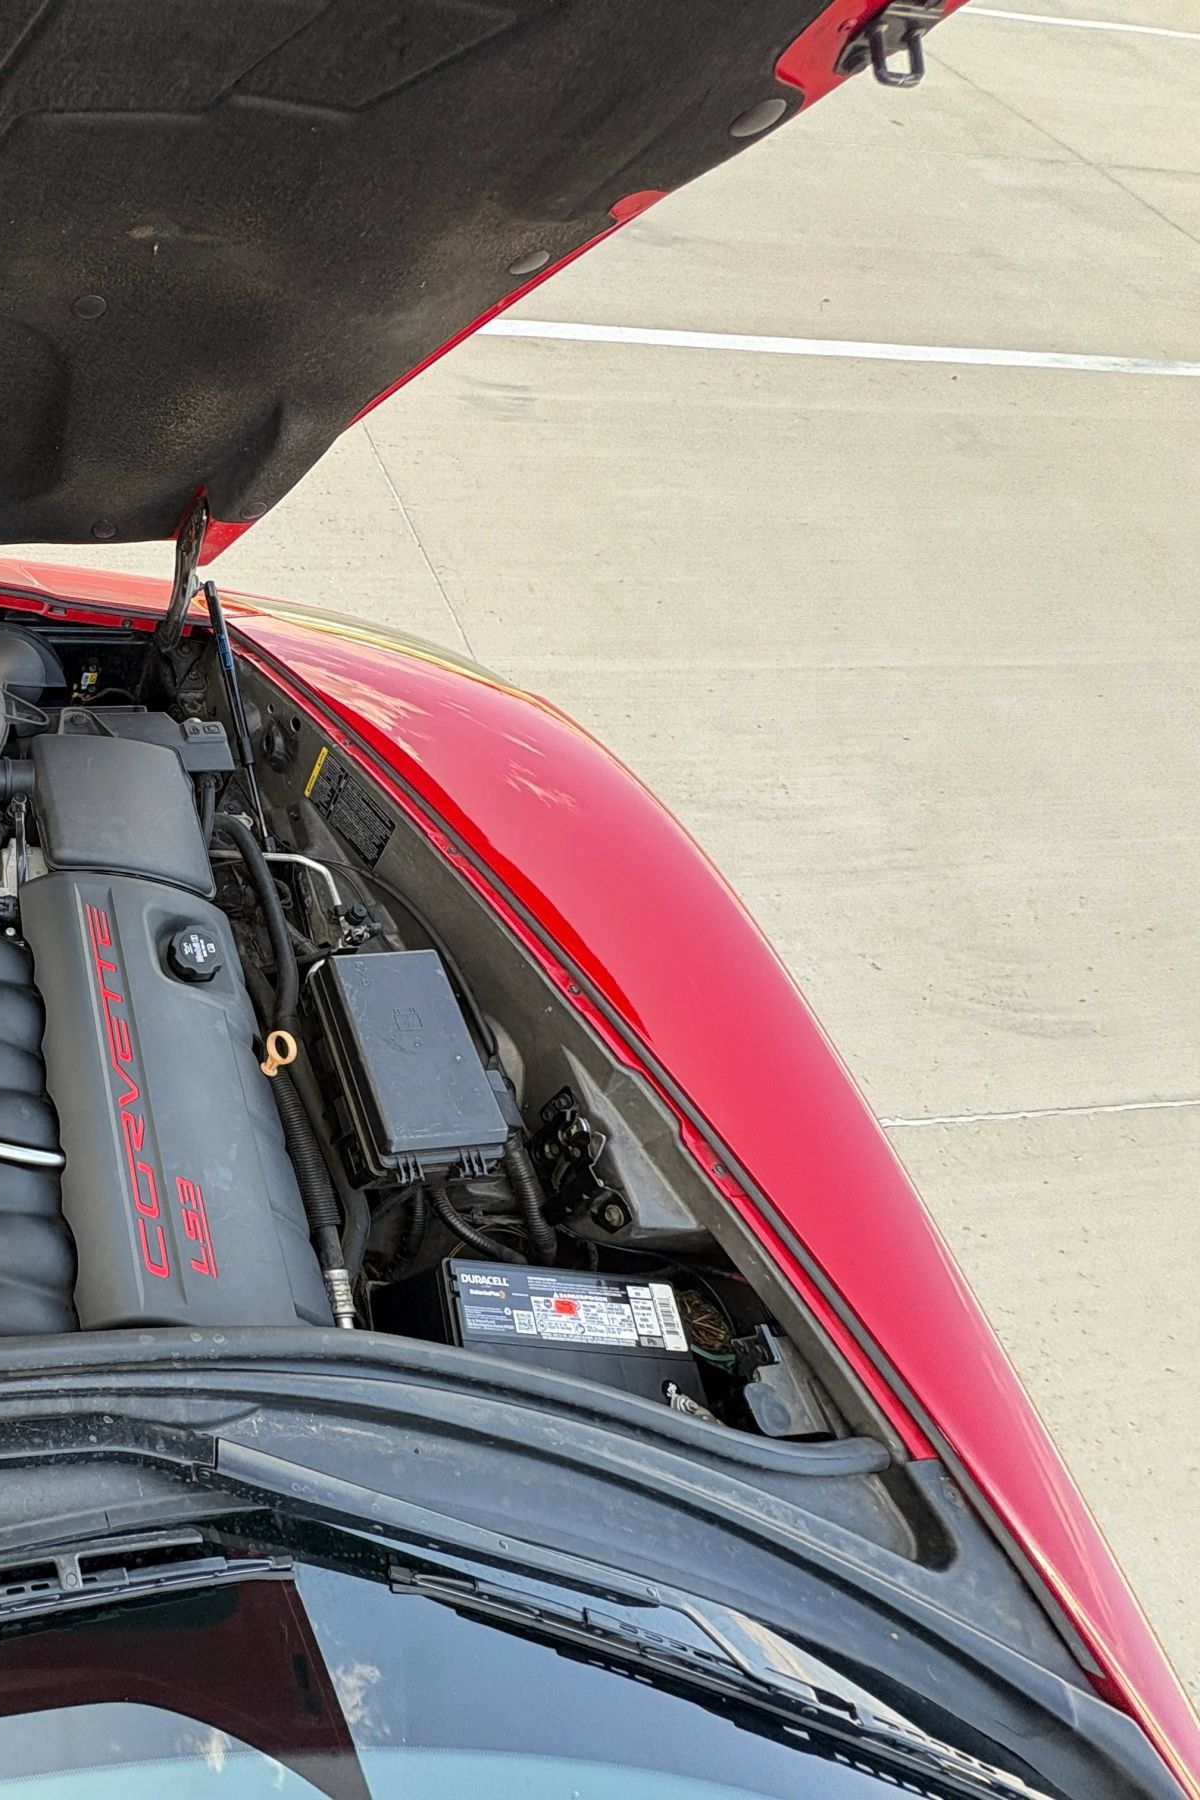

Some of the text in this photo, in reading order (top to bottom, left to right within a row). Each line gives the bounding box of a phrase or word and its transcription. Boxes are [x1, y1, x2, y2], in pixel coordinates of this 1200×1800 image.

[86, 907, 169, 1278] CORVETTE
[176, 1176, 217, 1278] LS3
[460, 1273, 510, 1287] DURACELL
